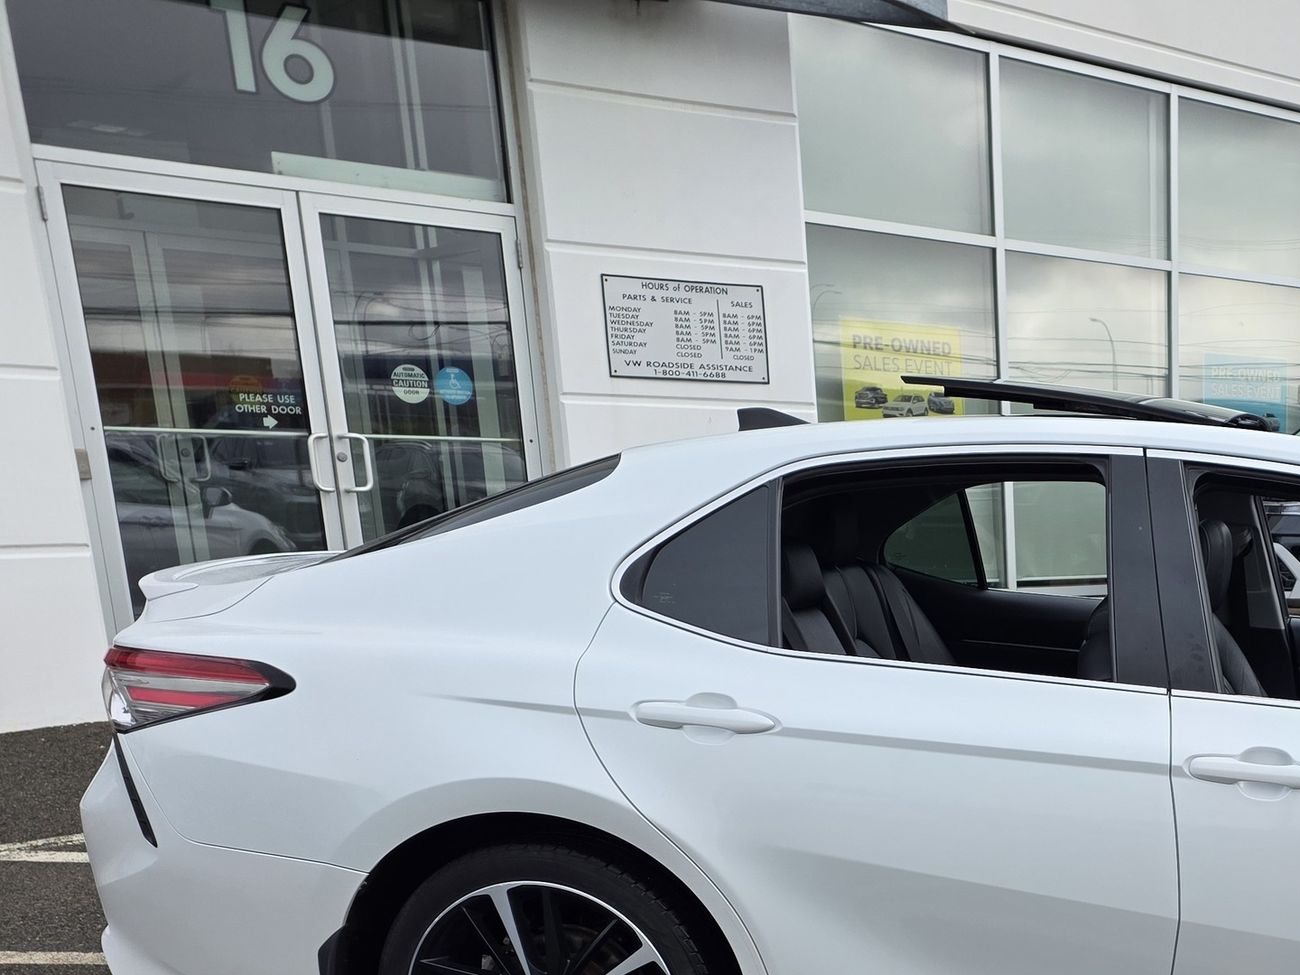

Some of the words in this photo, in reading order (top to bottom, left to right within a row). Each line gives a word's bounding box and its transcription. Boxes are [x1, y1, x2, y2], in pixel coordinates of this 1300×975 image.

[209, 0, 335, 102] 16
[641, 281, 669, 291] HOURS
[672, 284, 681, 292] of
[684, 284, 728, 295] OPERATION
[622, 293, 647, 301] PARTS
[661, 296, 692, 304] SERVICE
[610, 319, 654, 327] WEDNESDAY
[852, 334, 952, 356] PRE-OWNED
[646, 361, 694, 369] ROADSIDE
[699, 363, 753, 372] ASSISTANCE
[853, 355, 900, 373] SALES
[905, 359, 953, 376] EVENT
[654, 369, 726, 379] 1-800-411-6688
[392, 379, 428, 388] CAUTION
[239, 393, 273, 403] PLEASE
[277, 394, 296, 404] USE
[235, 404, 267, 414] OTHER
[271, 405, 302, 415] DOOR
